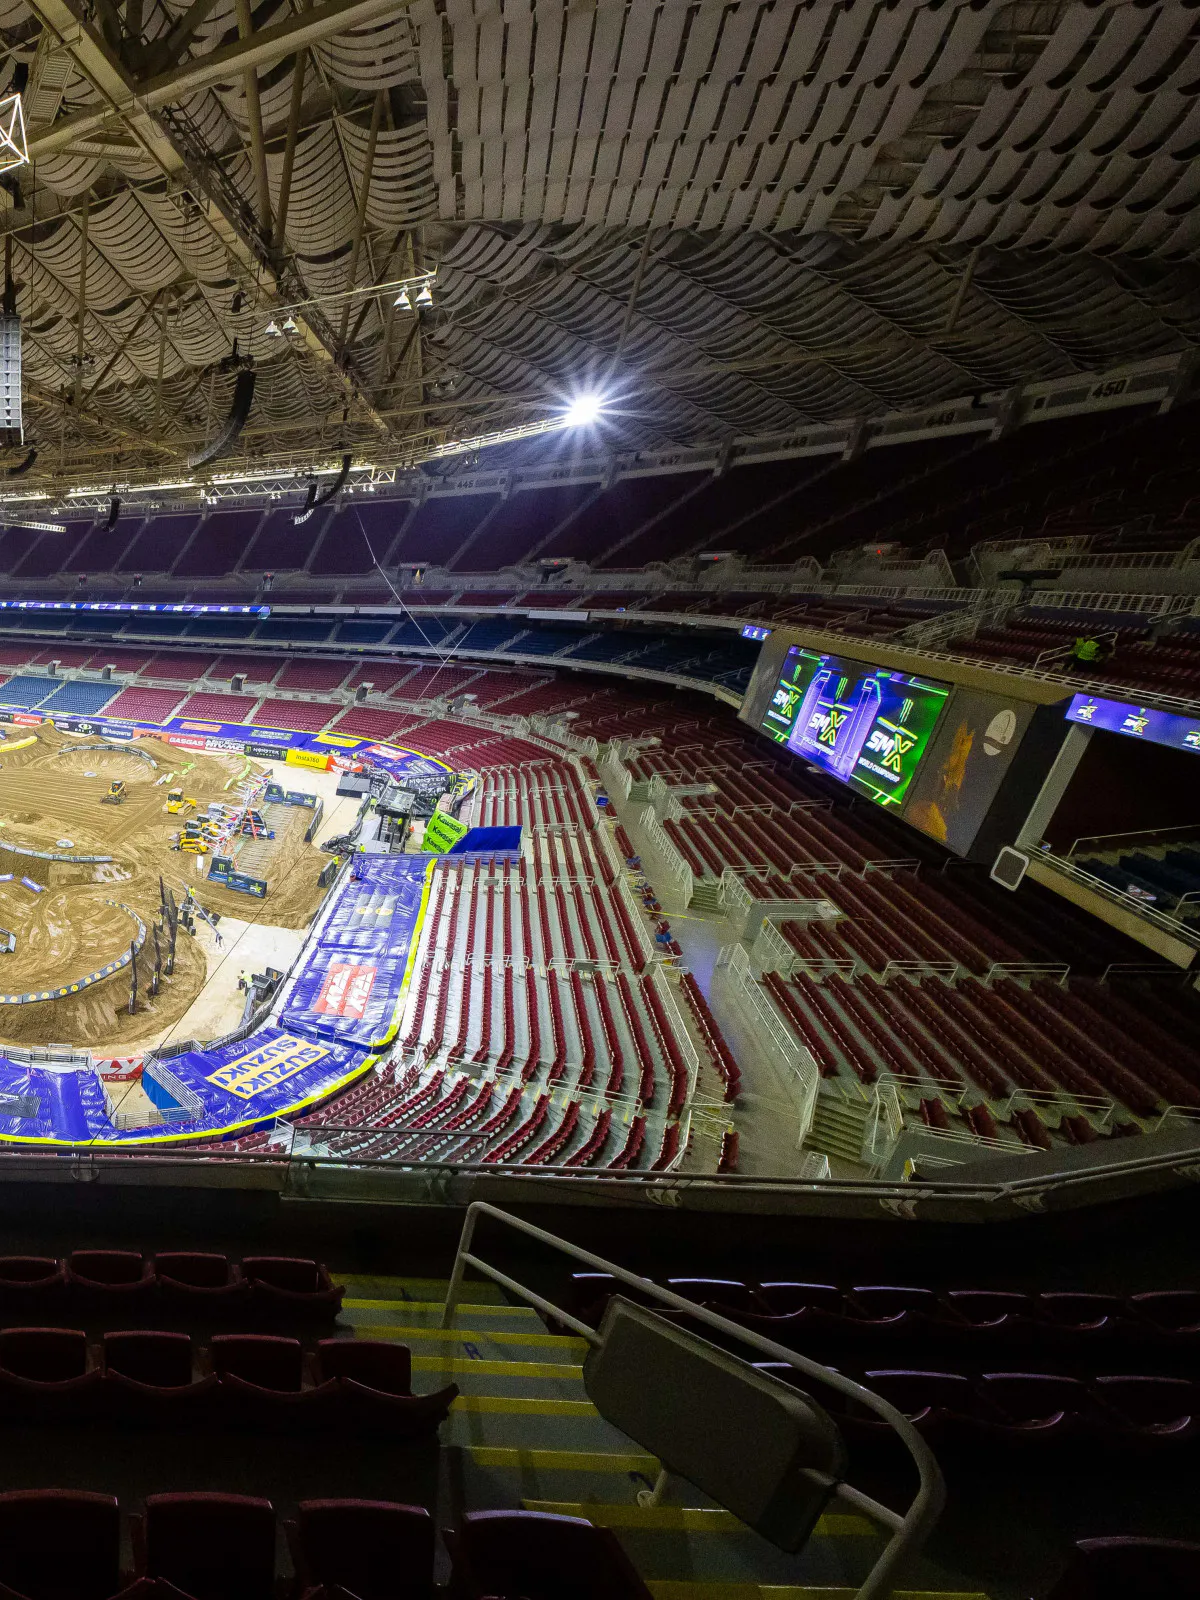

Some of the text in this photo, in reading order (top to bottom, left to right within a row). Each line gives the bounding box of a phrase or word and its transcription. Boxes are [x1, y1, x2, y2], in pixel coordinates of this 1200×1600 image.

[1093, 378, 1127, 399] 450
[659, 456, 681, 466] 447
[456, 480, 474, 489] 445
[773, 689, 800, 717] SMX
[20, 717, 40, 725] HONDA
[809, 711, 847, 746] SMX
[169, 737, 204, 746] GASGAS
[253, 747, 280, 755] MONSTER
[295, 754, 320, 763] Insta360
[866, 731, 913, 772] SMX
[409, 776, 447, 785] MONSTER
[437, 814, 463, 834] Kawasaki
[214, 1039, 298, 1087] SUZUKI
[235, 1047, 321, 1095] SUZUKI
